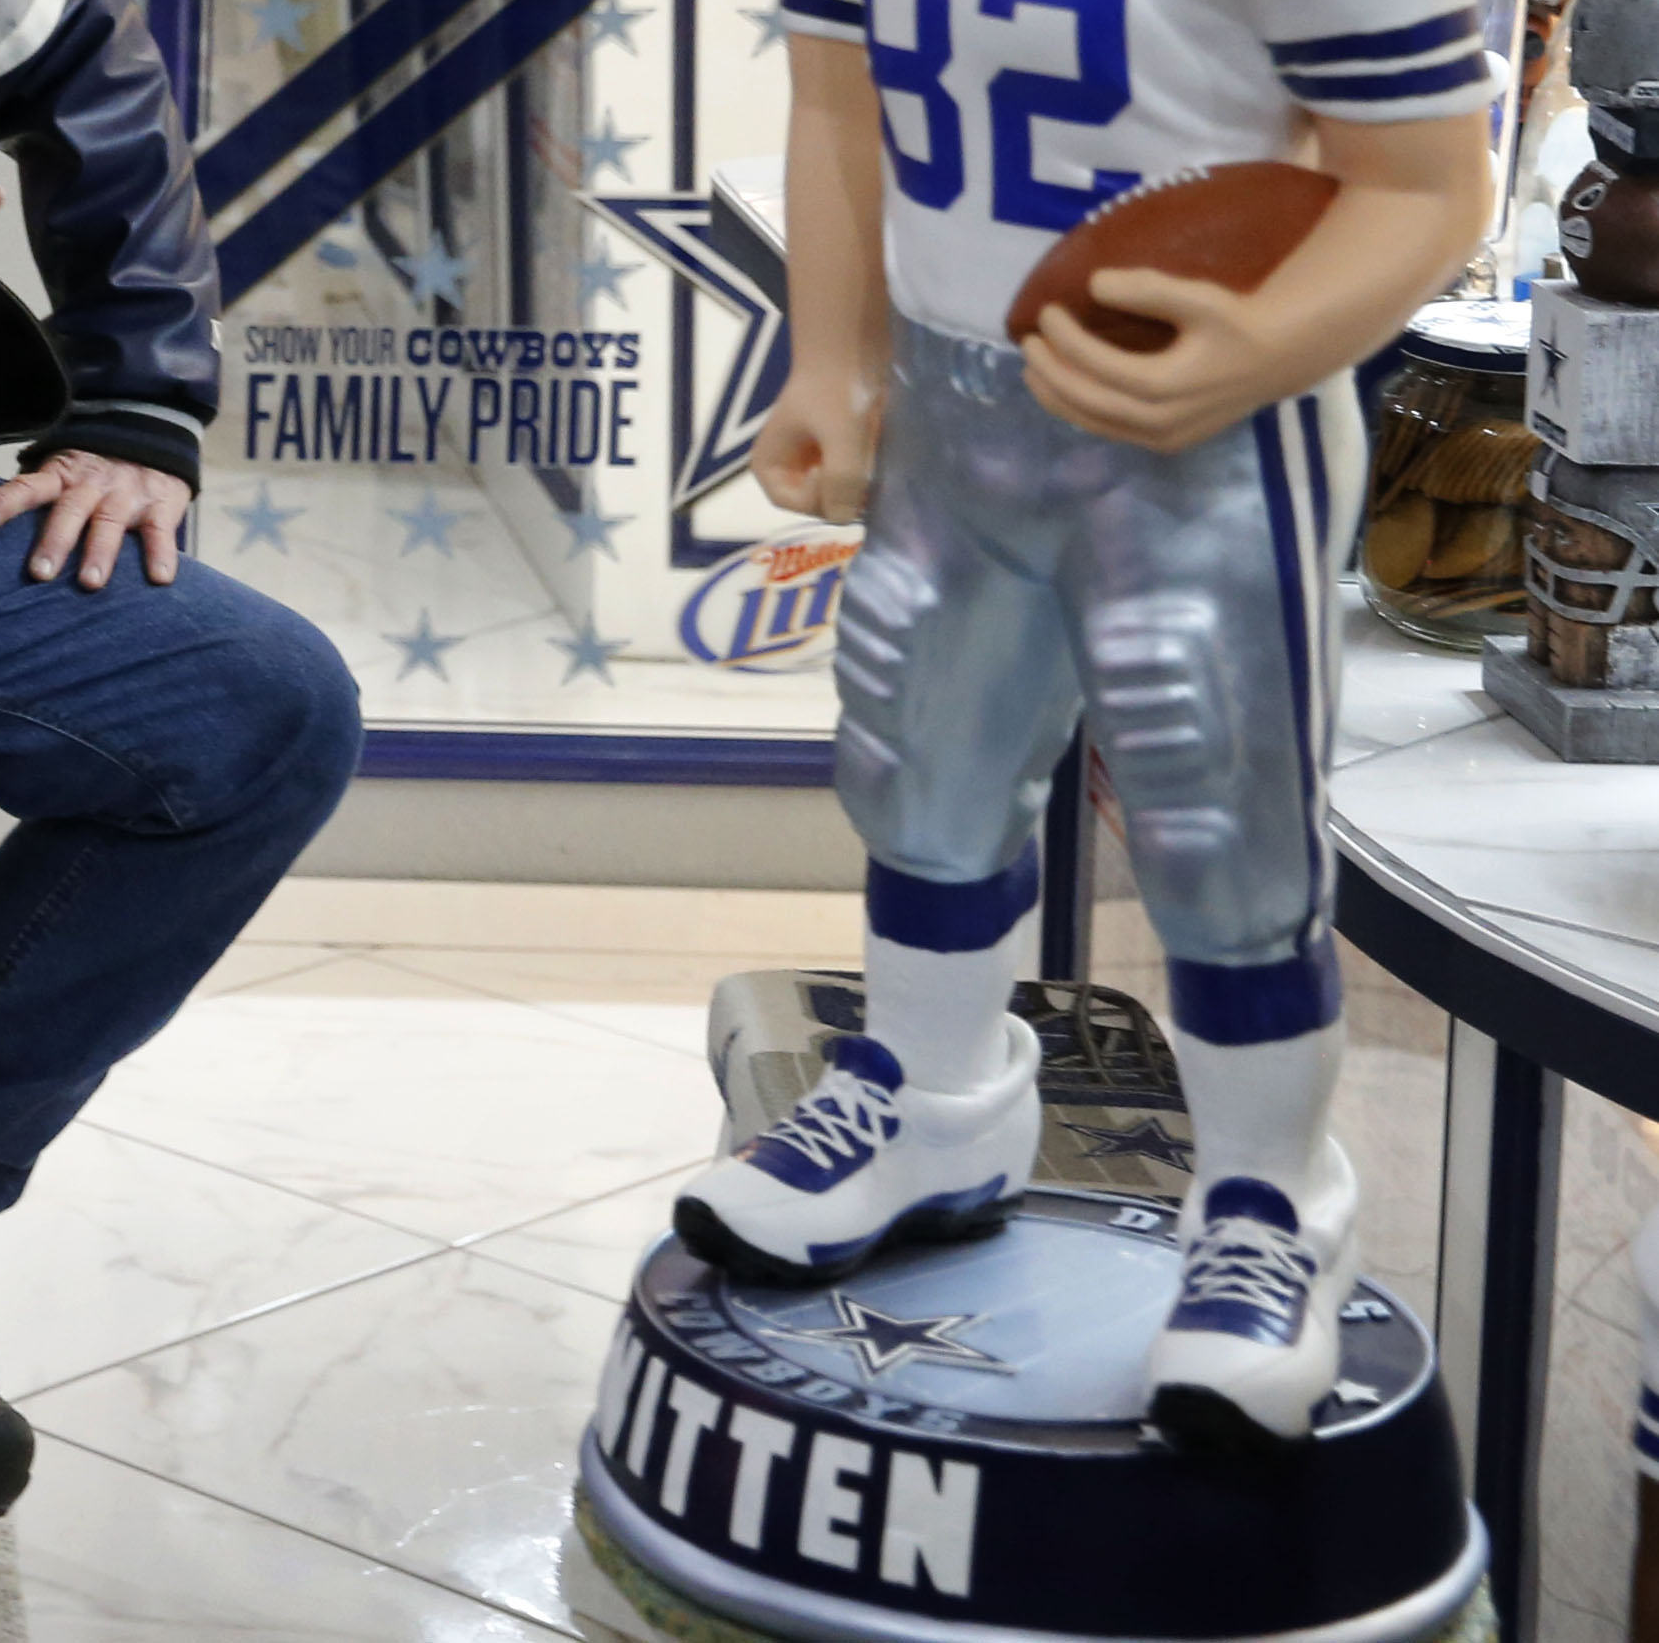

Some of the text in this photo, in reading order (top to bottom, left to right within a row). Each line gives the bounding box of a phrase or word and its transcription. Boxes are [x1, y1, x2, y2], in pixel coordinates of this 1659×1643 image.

[243, 326, 640, 370] SHOW YOUR COWBOYS
[246, 373, 640, 467] FAMILY PRIDE
[717, 565, 844, 665] Lit
[657, 1292, 968, 1435] COWBOYS
[596, 1320, 982, 1600] WITTEN
